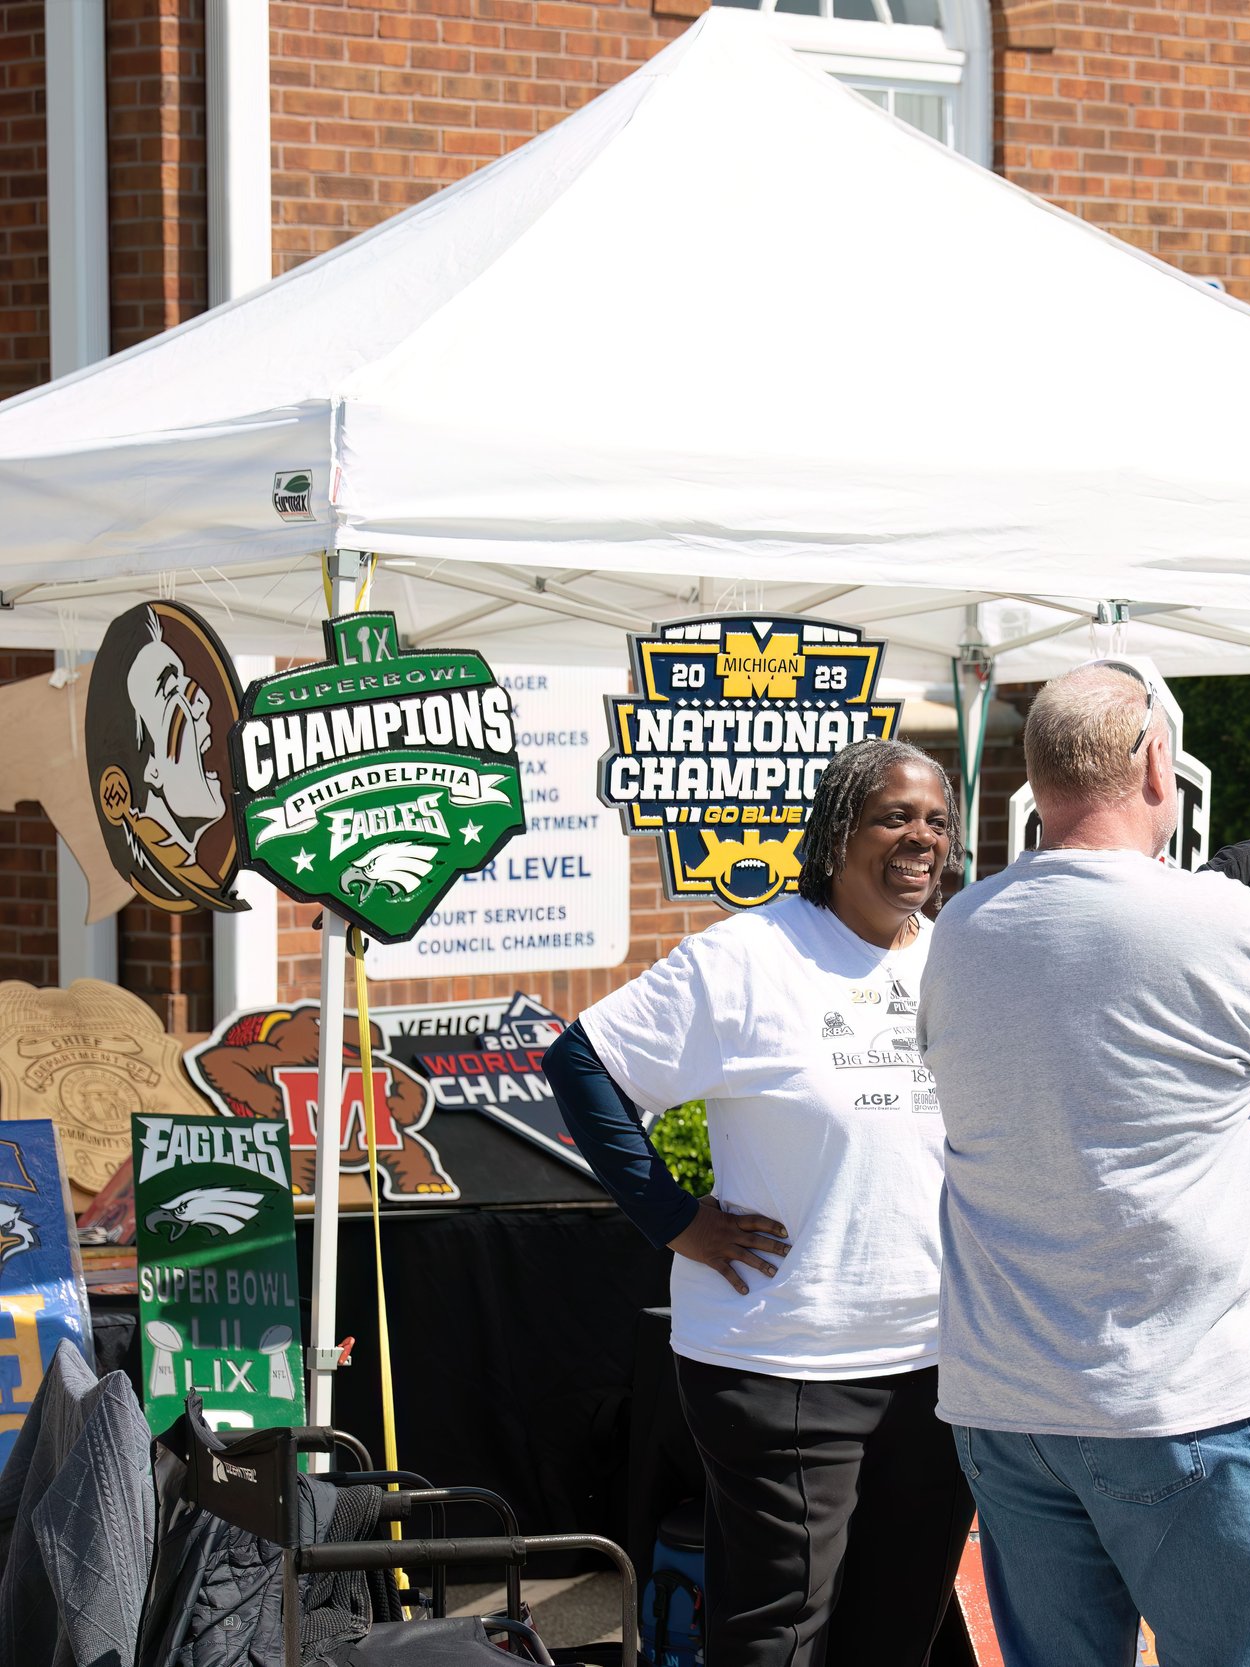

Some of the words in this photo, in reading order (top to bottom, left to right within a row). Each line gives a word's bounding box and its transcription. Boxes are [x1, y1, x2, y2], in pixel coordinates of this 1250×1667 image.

[672, 664, 705, 688] 20
[723, 658, 799, 673] MICHIGAN
[814, 666, 847, 689] 23
[267, 665, 476, 705] SUPERBOWL
[498, 675, 547, 690] AGER
[242, 685, 513, 793] CHAMPIONS
[636, 708, 876, 752] NATIONAL
[292, 766, 470, 813] PHILADELPHIA
[323, 792, 450, 860] EAGLES
[704, 806, 739, 823] GO
[742, 806, 803, 823] BLUE
[509, 856, 592, 881] LEVEL
[484, 906, 567, 923] SERVICES
[418, 939, 496, 955] COUNCIL
[502, 932, 595, 950] CHAMBERS
[399, 1012, 500, 1036] VEHICL
[822, 1026, 854, 1038] KBA
[51, 1033, 103, 1050] CHIEF
[34, 1051, 119, 1078] DEPARTMENT
[861, 1093, 894, 1105] LGE
[136, 1117, 290, 1190] EAGLES
[140, 1265, 219, 1304] SUPER
[226, 1269, 296, 1307] BOWL
[191, 1316, 242, 1351] LII
[158, 1366, 173, 1376] NFL
[184, 1357, 258, 1393] LIX
[272, 1370, 287, 1380] NFL
